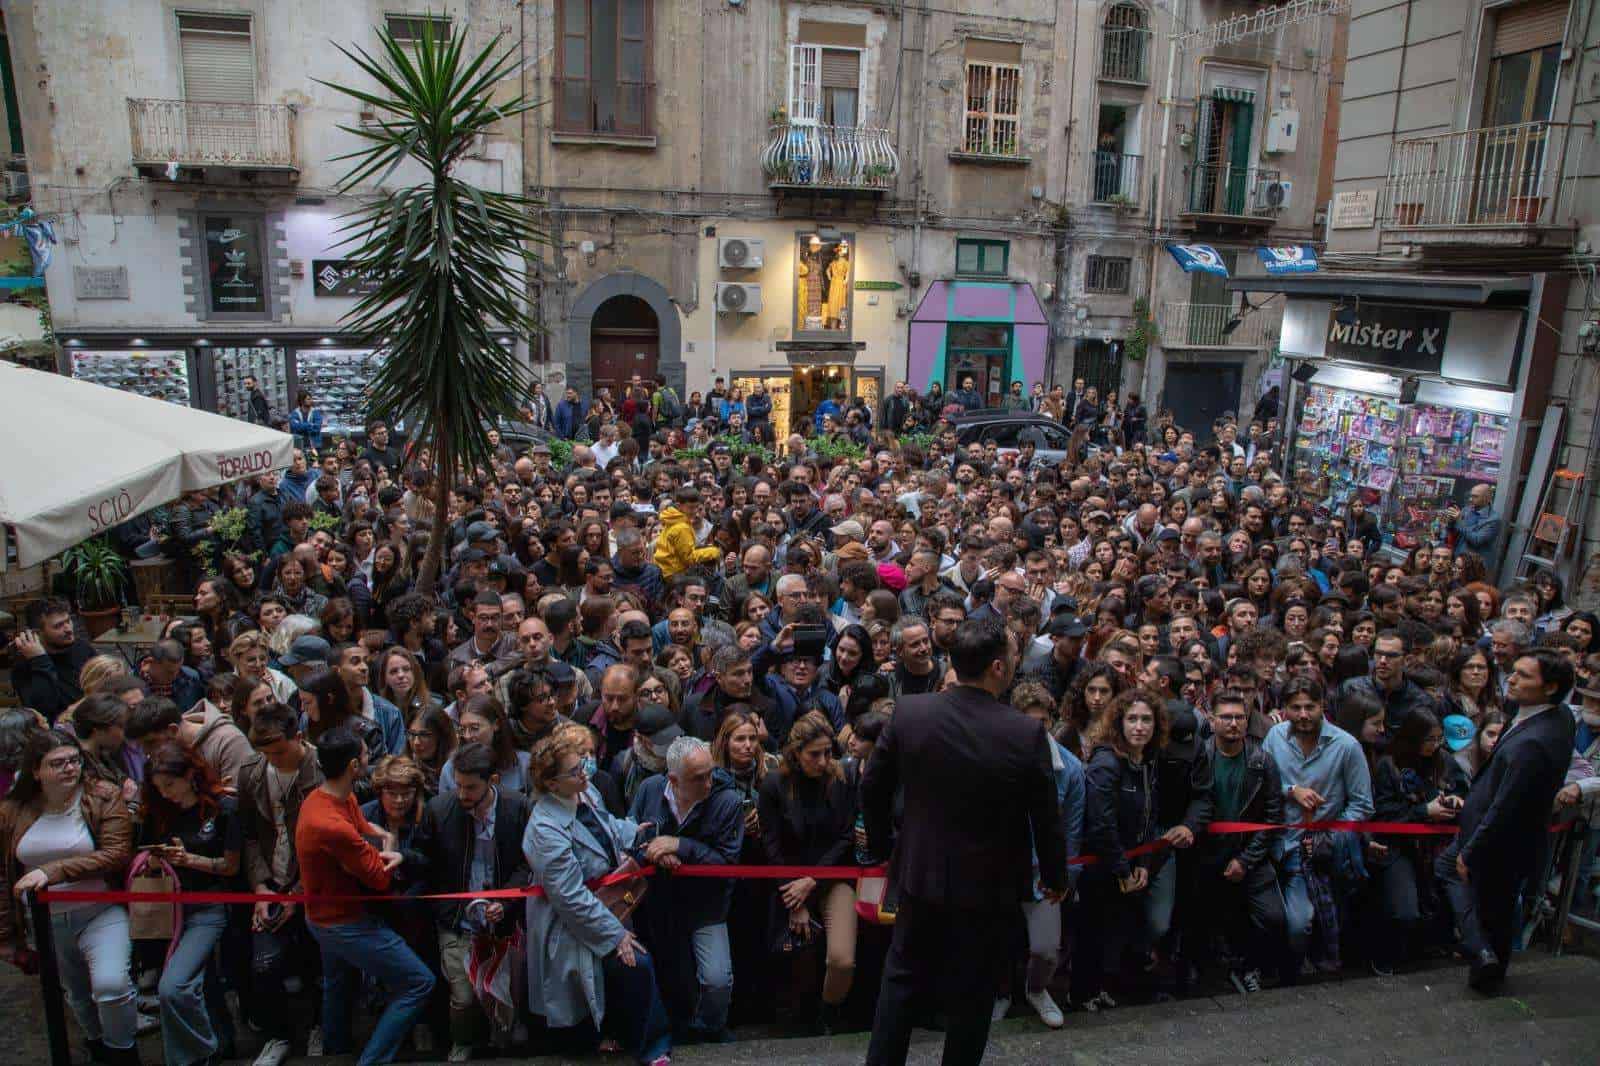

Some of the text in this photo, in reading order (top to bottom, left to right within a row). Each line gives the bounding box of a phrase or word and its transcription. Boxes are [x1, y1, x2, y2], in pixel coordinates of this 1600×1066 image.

[1329, 318, 1441, 355] Mister X
[217, 450, 272, 480] TORALDO
